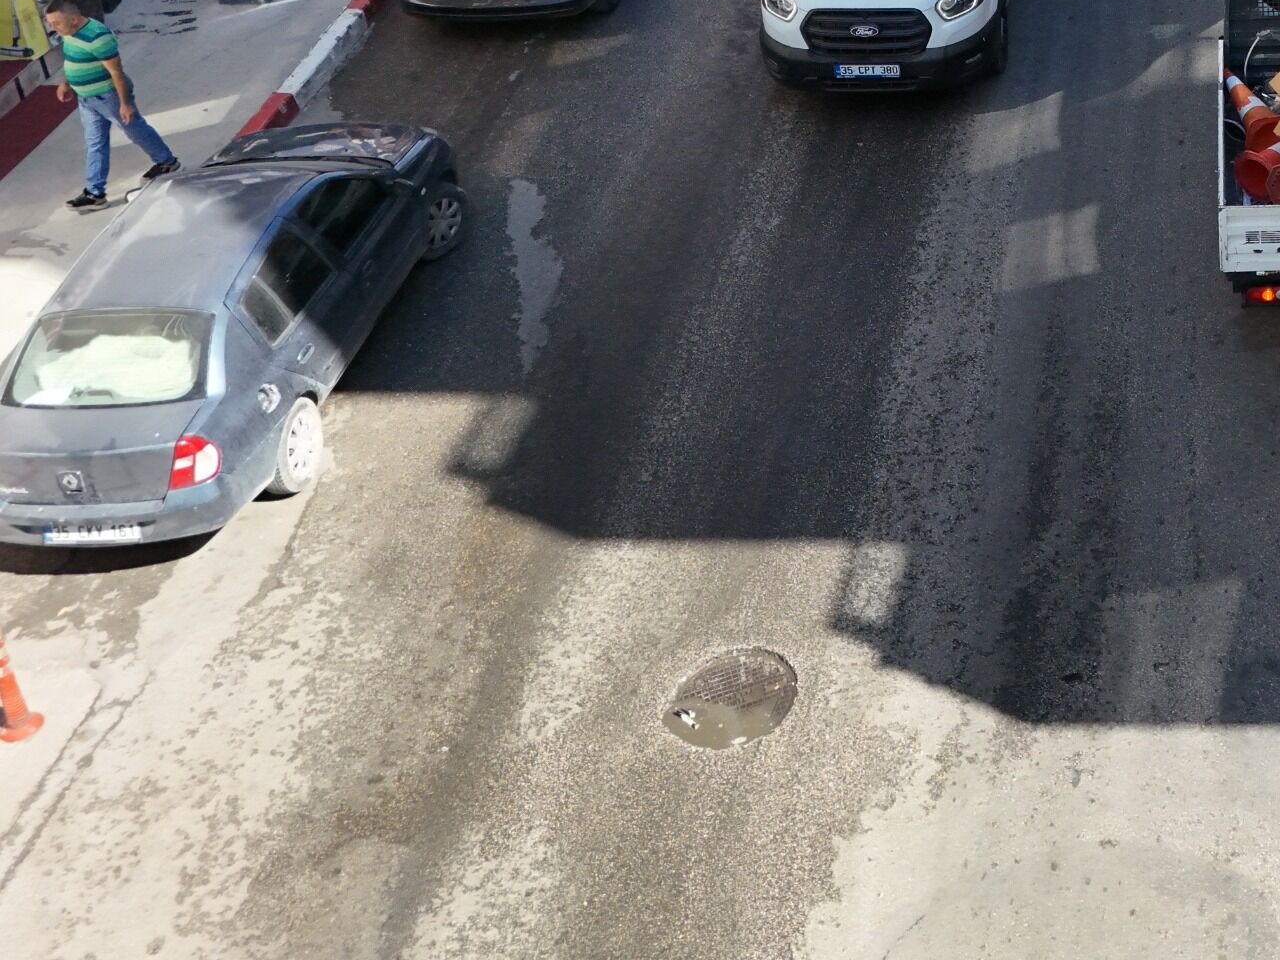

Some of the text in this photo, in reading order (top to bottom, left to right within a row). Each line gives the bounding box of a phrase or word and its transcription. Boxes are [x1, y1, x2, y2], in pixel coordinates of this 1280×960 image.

[854, 26, 873, 36] Ford
[840, 65, 899, 76] 35 CPT 380
